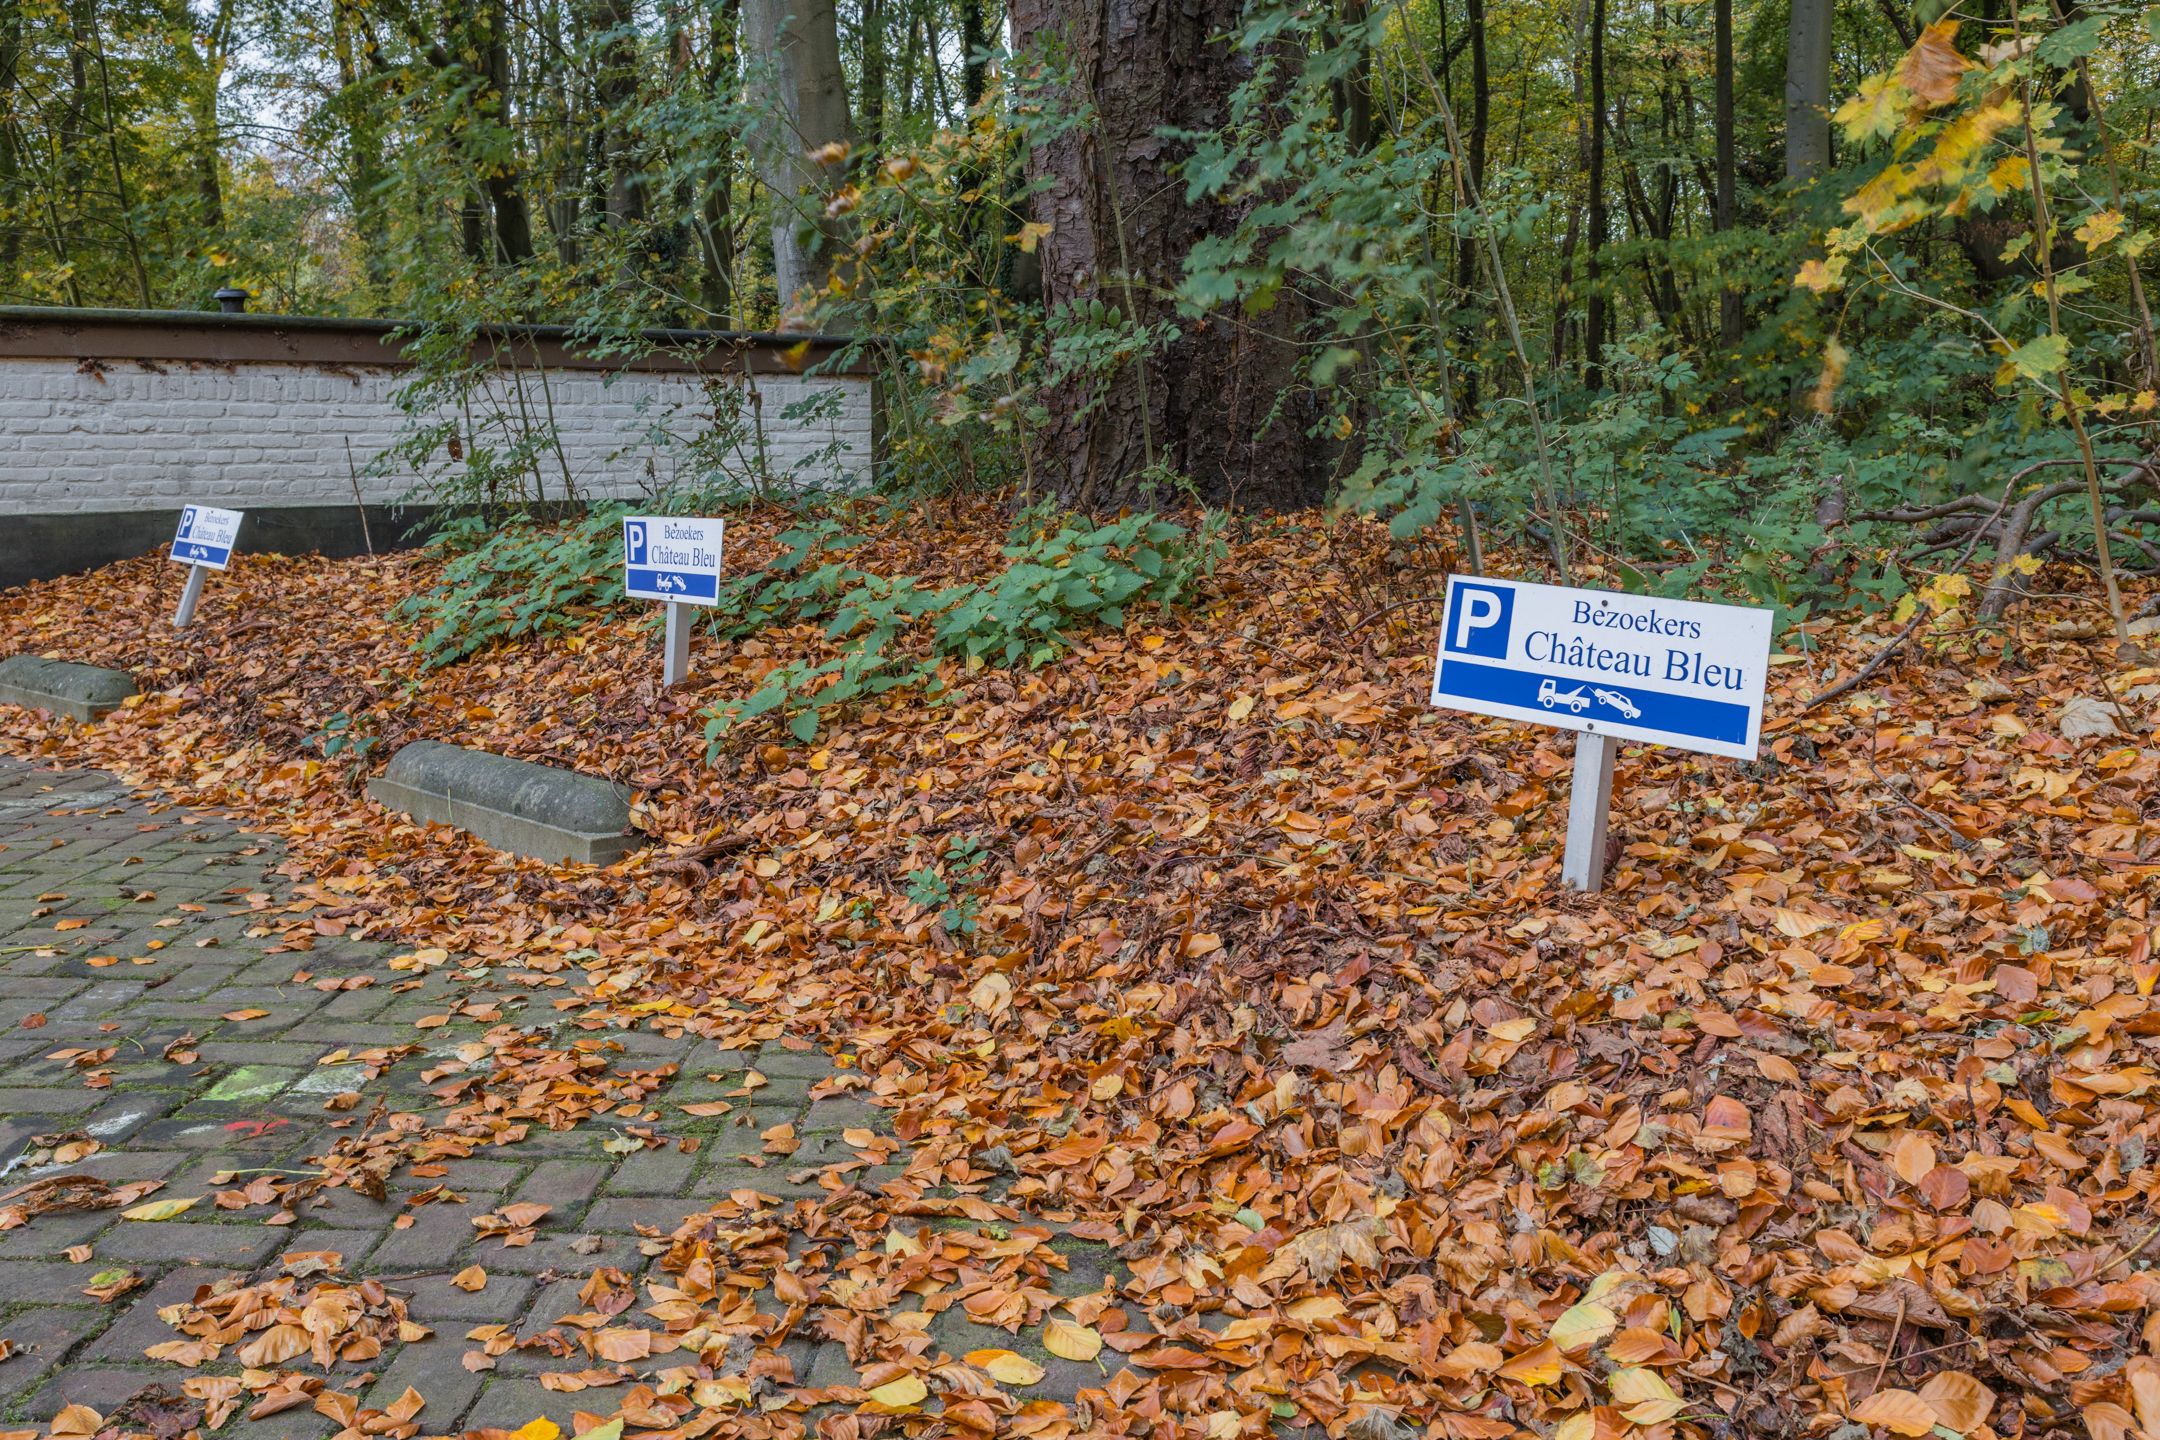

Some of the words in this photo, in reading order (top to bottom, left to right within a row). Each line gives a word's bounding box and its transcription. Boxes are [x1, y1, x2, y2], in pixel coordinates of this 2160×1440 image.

[180, 509, 194, 536] P
[216, 529, 233, 544] Bleu
[664, 524, 704, 541] Bezoekers
[629, 524, 644, 561] P
[651, 545, 690, 566] Château
[692, 547, 716, 568] Bleu
[1455, 588, 1502, 649] P
[1572, 600, 1702, 639] Bezoekers
[1524, 630, 1651, 677] Château
[1662, 648, 1744, 691] Bleu
